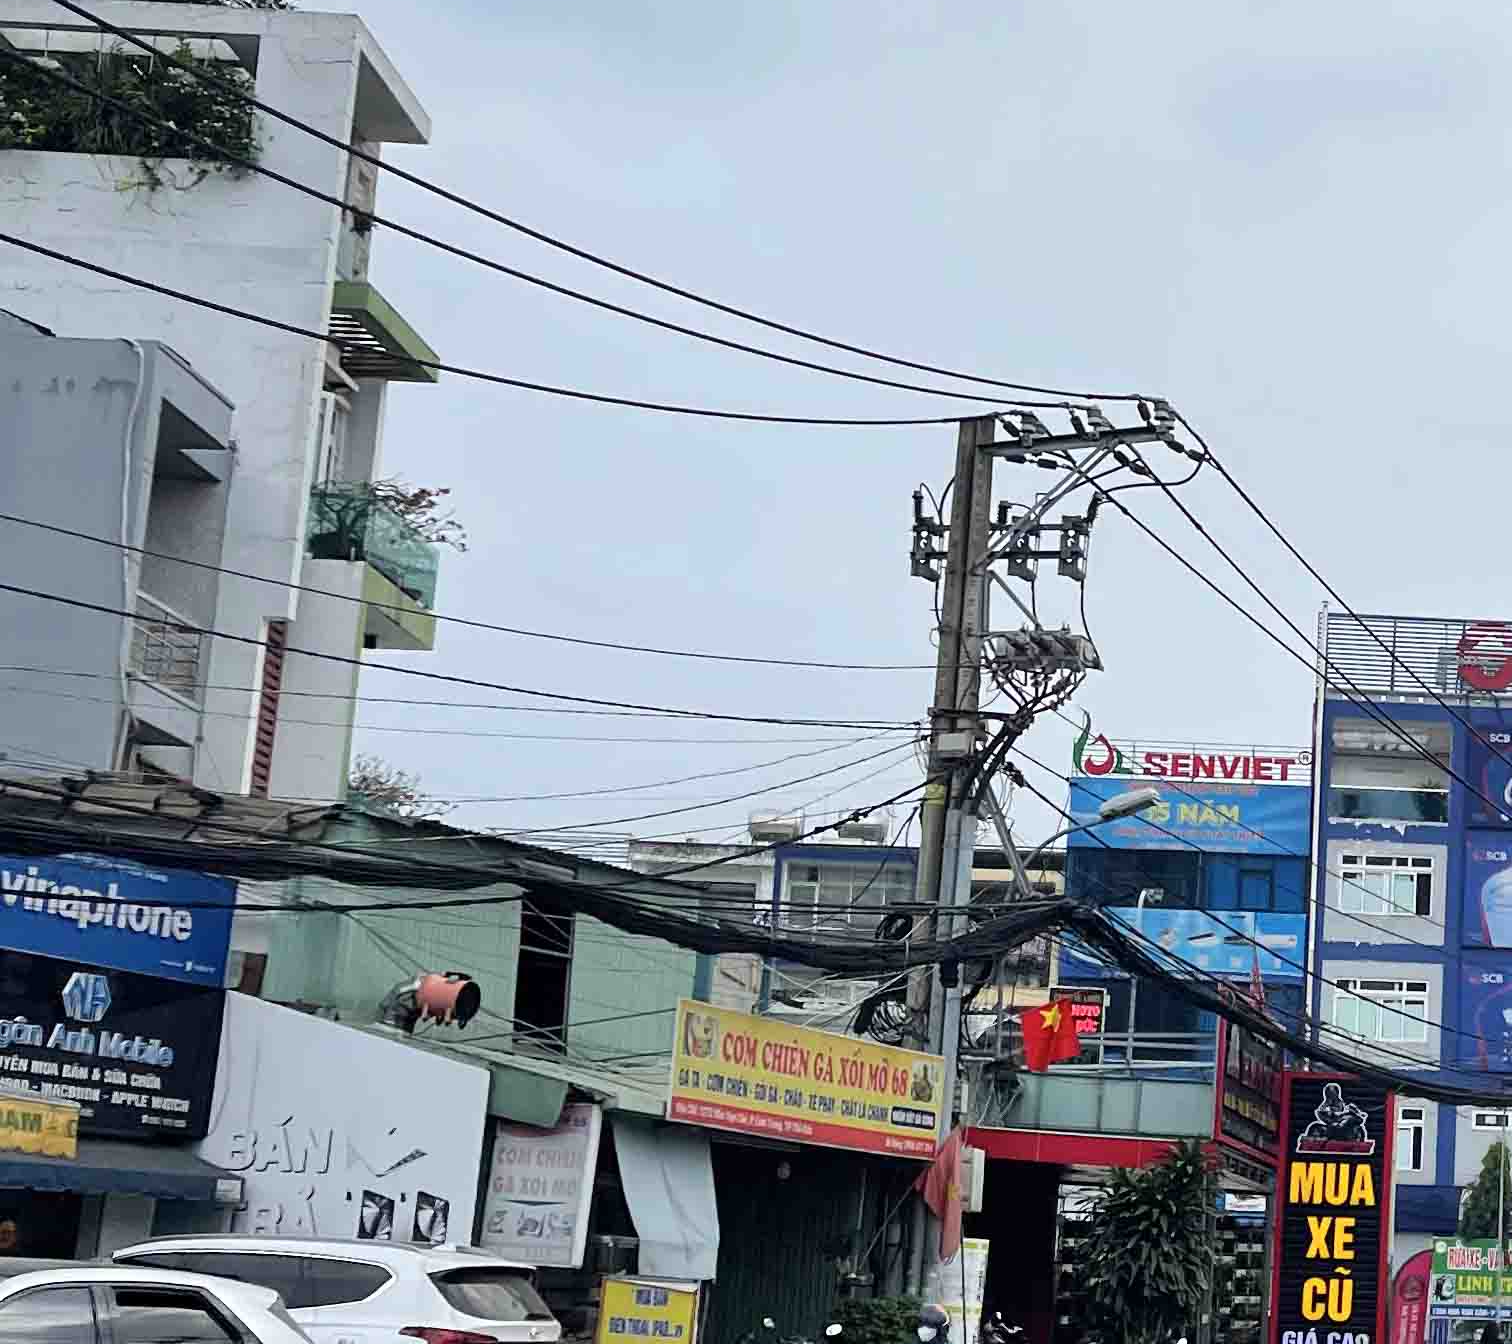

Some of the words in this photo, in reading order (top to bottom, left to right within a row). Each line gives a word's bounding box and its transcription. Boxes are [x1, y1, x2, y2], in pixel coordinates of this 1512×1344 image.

[1488, 733, 1511, 744] SCB
[1142, 752, 1297, 782] SENVIET
[1486, 850, 1508, 862] SCB
[0, 865, 193, 942] vinaphone
[1481, 973, 1505, 985] SCB
[47, 1023, 96, 1056] Anh
[762, 1040, 810, 1079] CHIÊN
[891, 1067, 909, 1097] 68
[228, 1116, 334, 1175] BÁN
[1289, 1161, 1376, 1207] MUA
[1305, 1215, 1356, 1260] XE
[1301, 1266, 1354, 1322] CŨ
[1457, 1276, 1493, 1293] LINH
